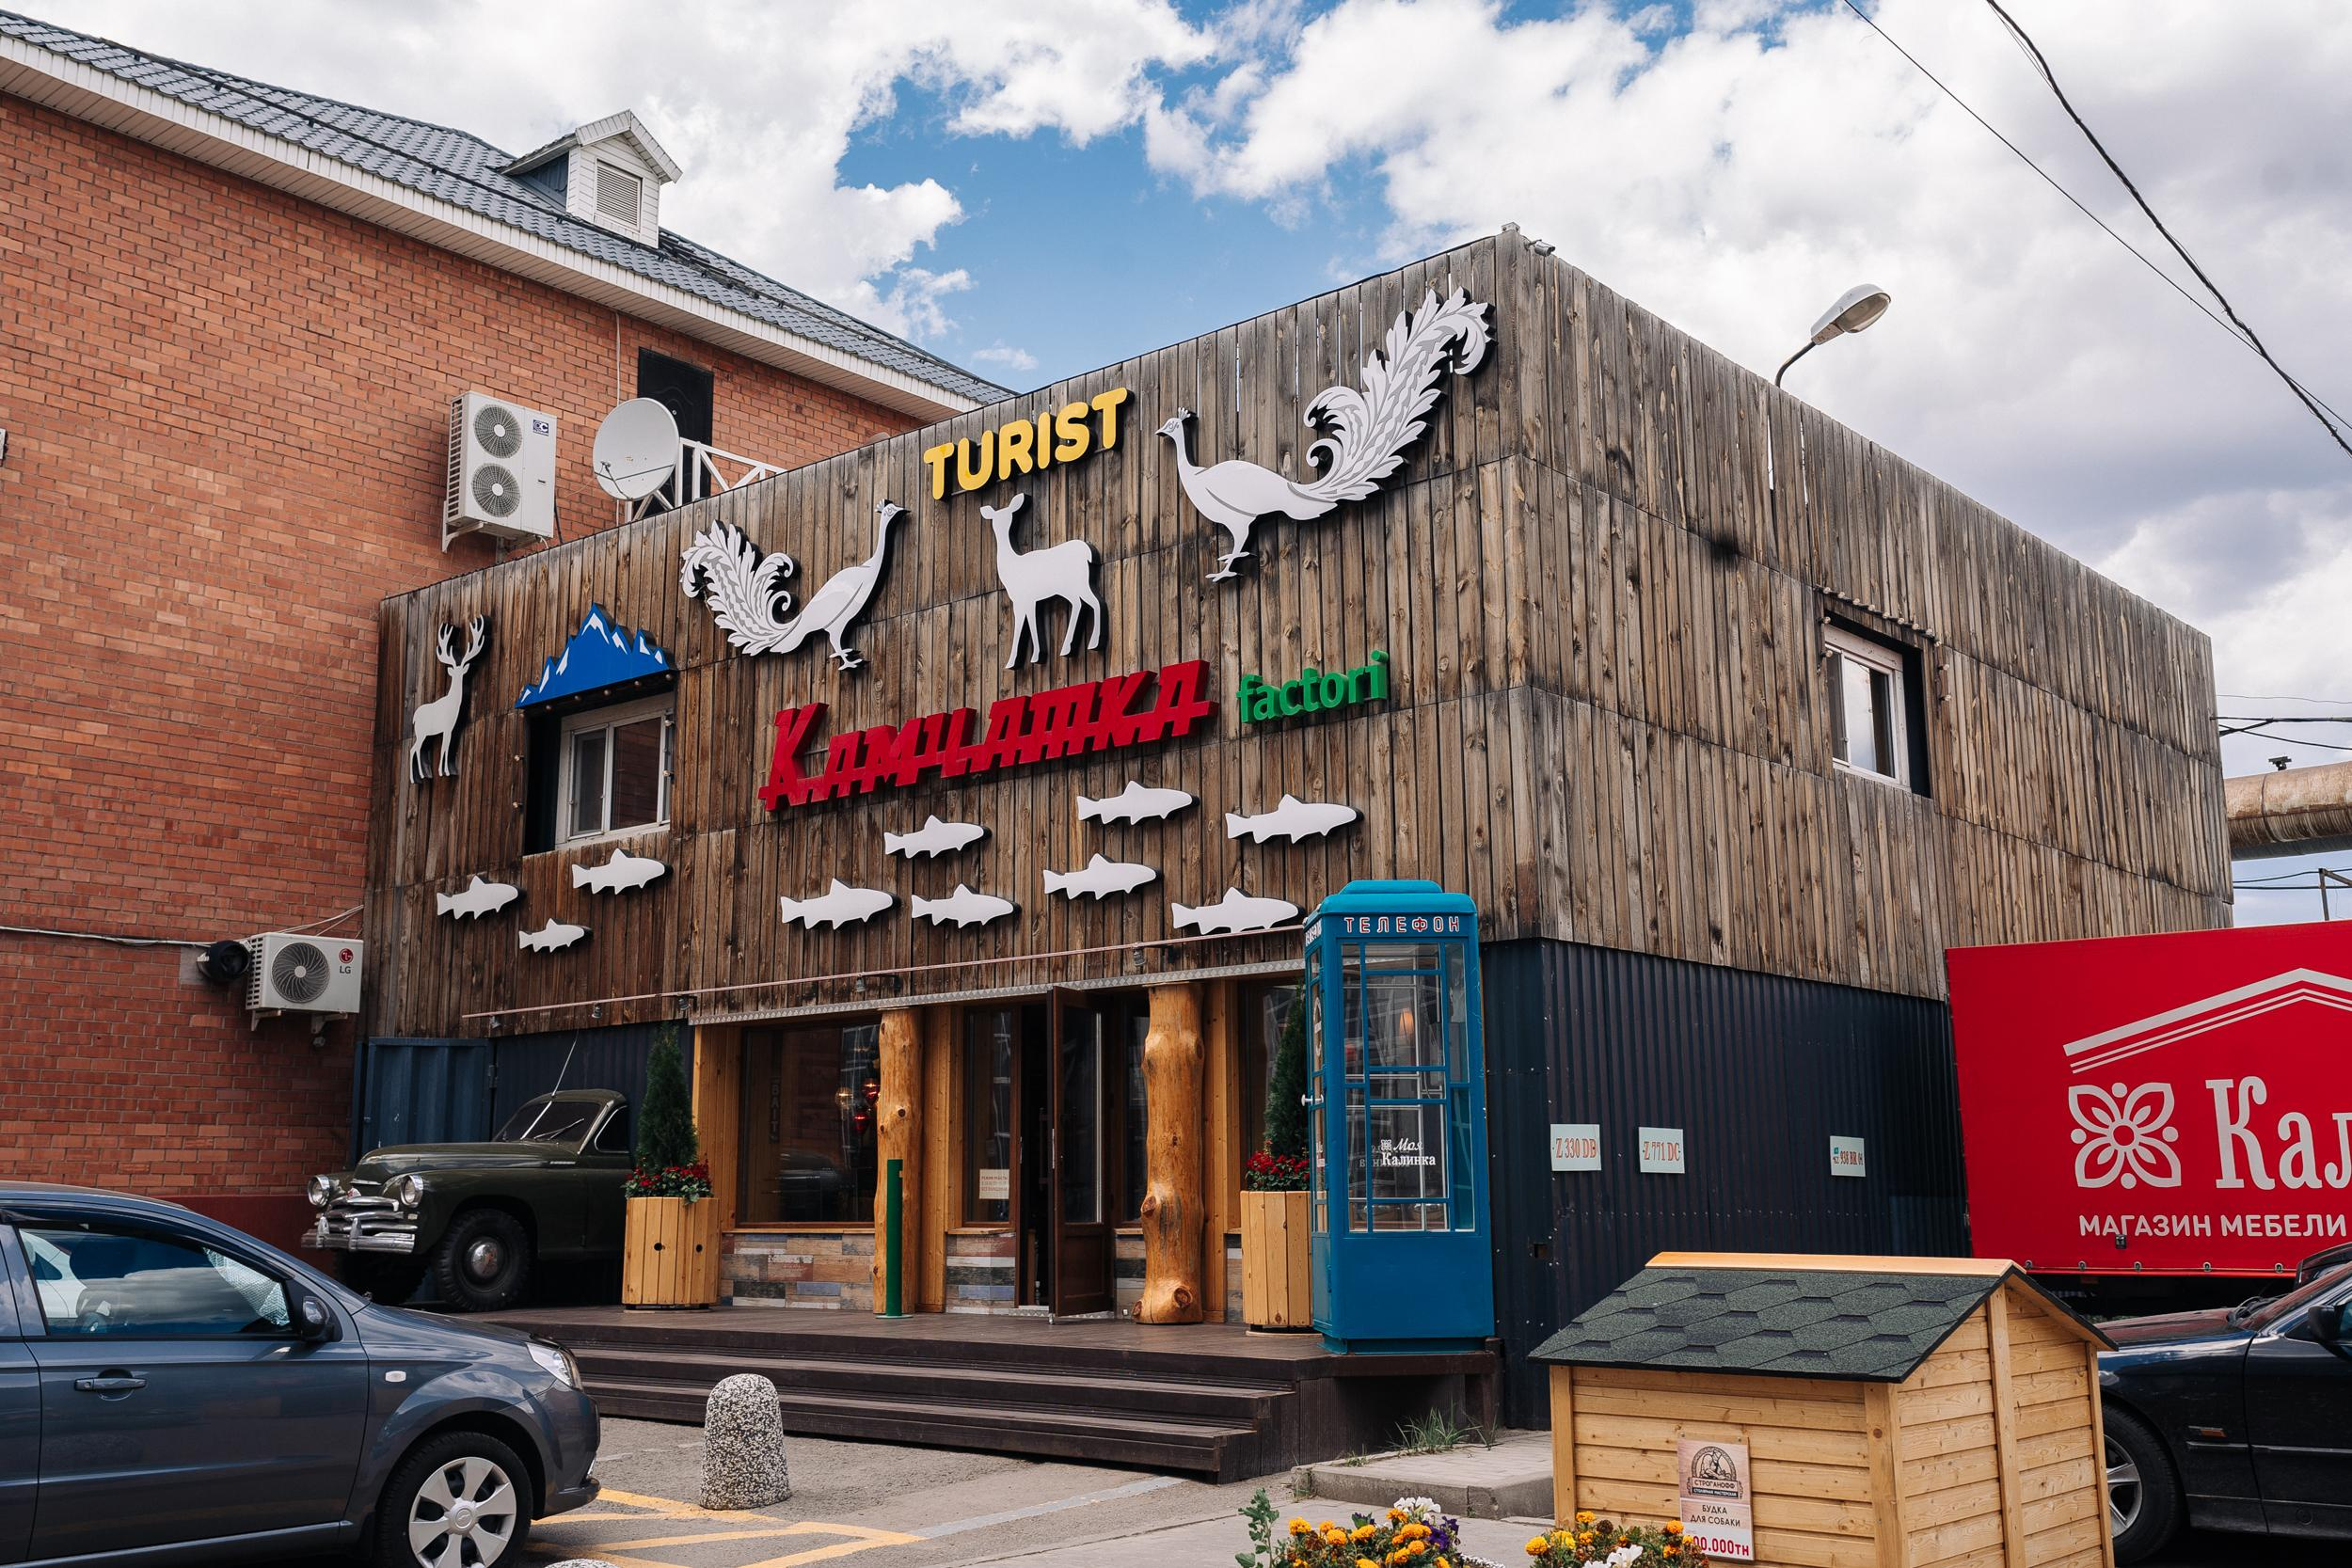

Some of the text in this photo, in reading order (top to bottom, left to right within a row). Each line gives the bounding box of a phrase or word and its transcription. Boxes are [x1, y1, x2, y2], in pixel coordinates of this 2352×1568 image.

[923, 387, 1131, 500] TURIST
[1236, 649, 1389, 723] factori
[1343, 916, 1460, 933] ТЕЛЕФОН
[340, 965, 352, 974] LG
[1393, 1137, 1424, 1151] Моя
[1555, 1138, 1563, 1159] Z
[1565, 1138, 1581, 1158] 330
[1644, 1141, 1650, 1161] Z
[1666, 1142, 1680, 1162] DC
[1382, 1152, 1437, 1166] Калинка
[2078, 1213, 2347, 1237] МАГАЗИН МЕБЕЛИ
[1694, 1480, 1736, 1489] СТРОГАНОФФ
[1702, 1504, 1727, 1515] БУДКА
[1690, 1515, 1740, 1528] ДЛЯ СОБАКИ
